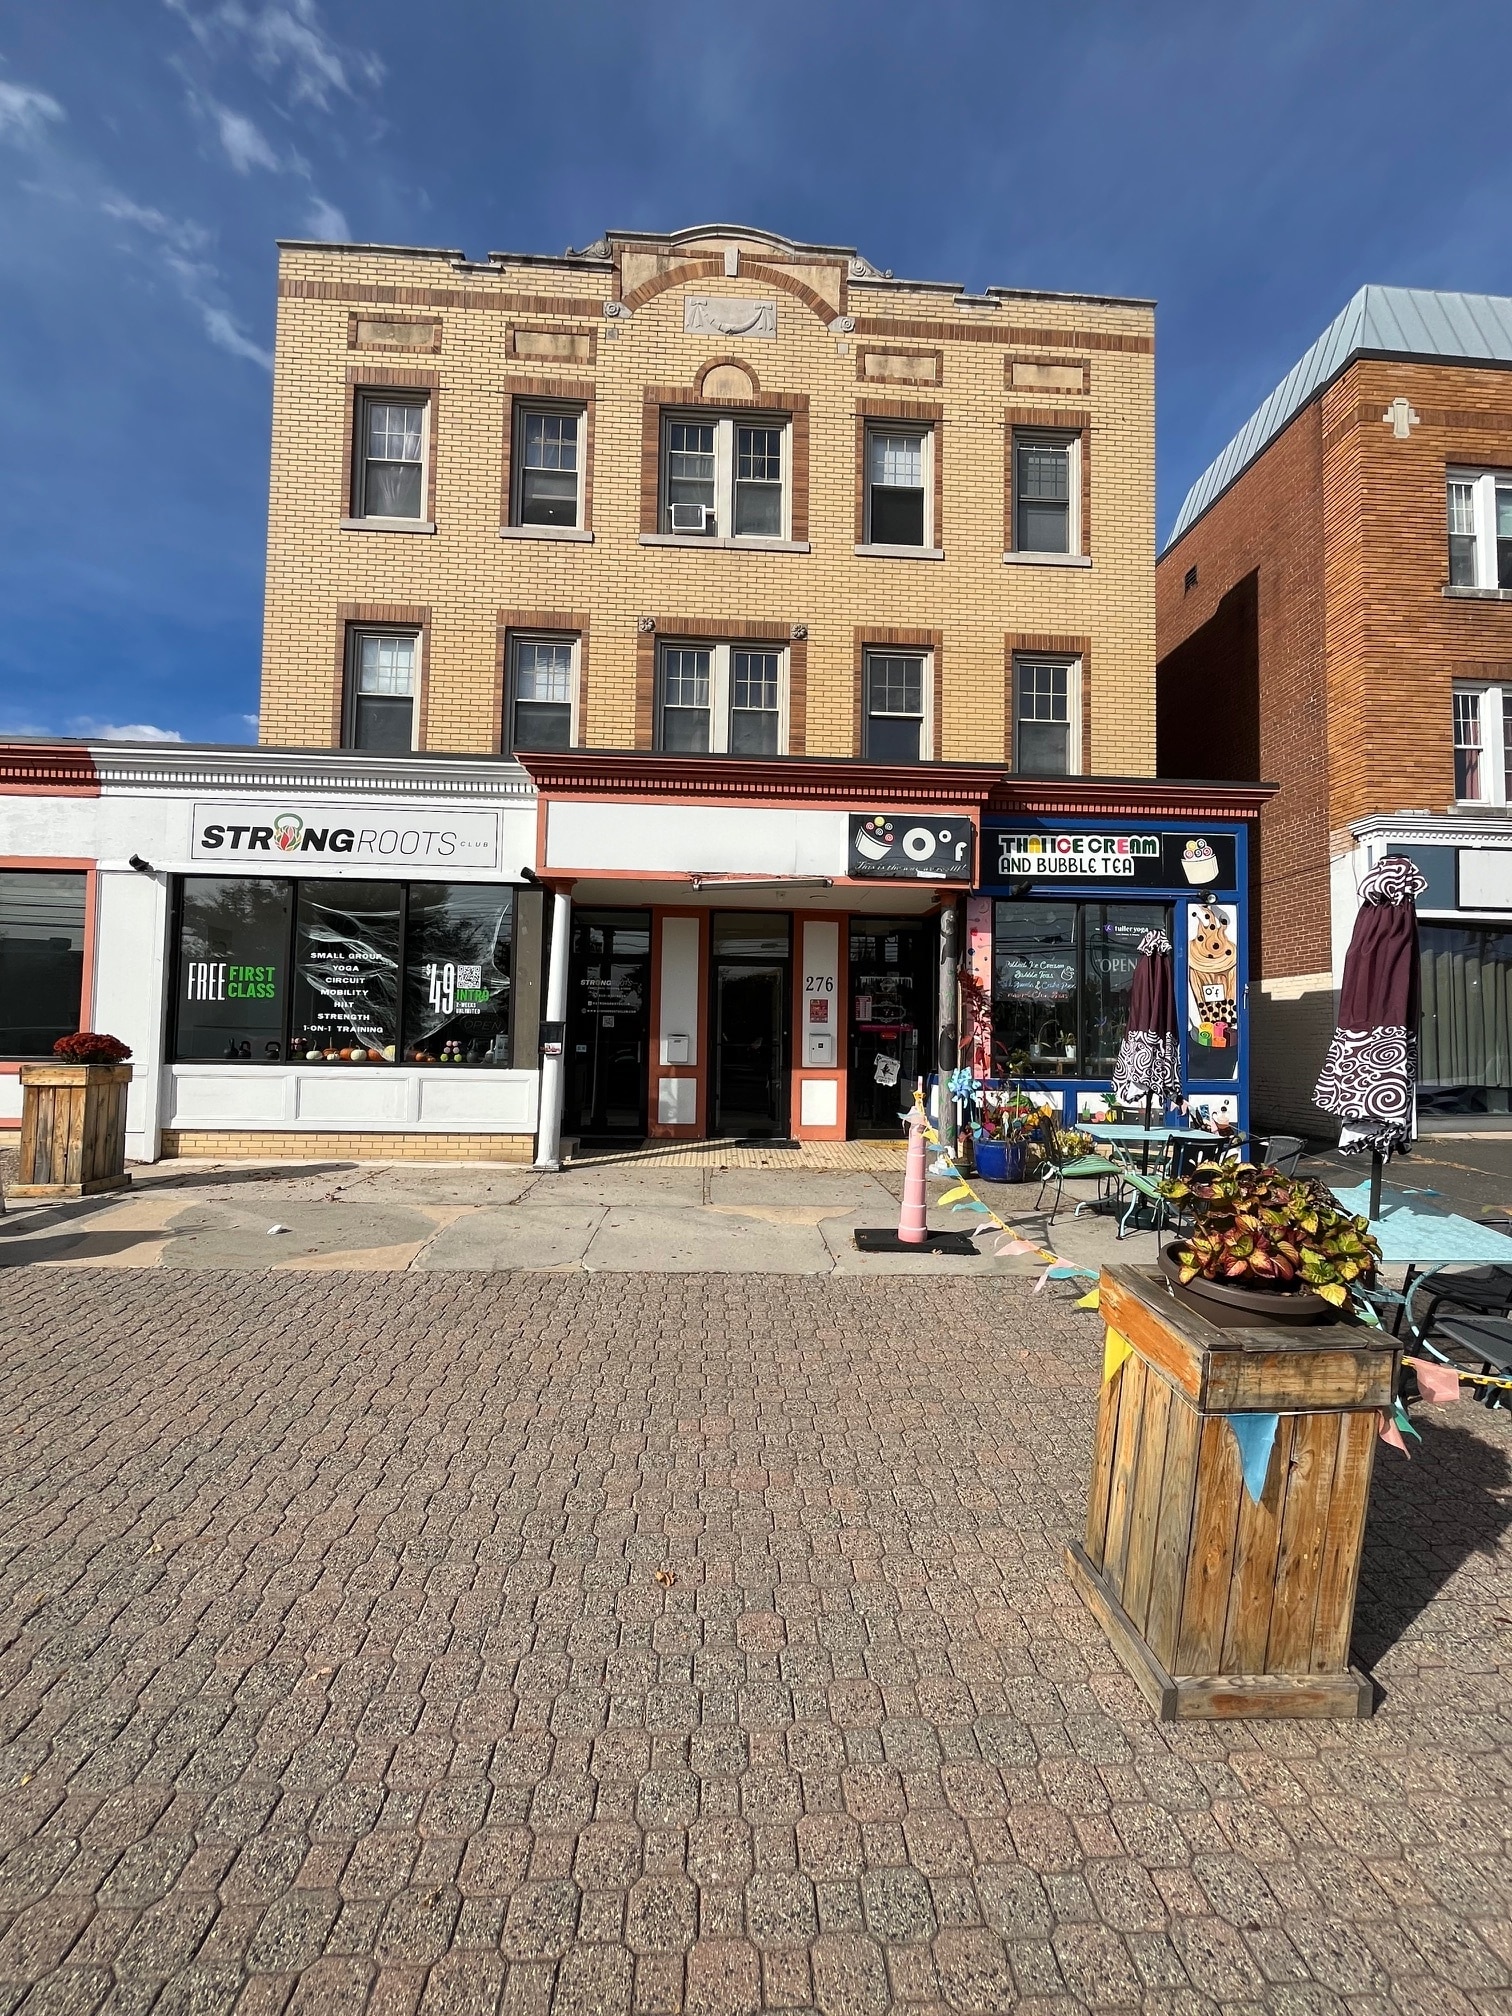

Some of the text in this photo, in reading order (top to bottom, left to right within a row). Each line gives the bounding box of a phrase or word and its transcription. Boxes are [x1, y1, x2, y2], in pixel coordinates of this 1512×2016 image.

[460, 840, 490, 848] CLUB
[1001, 836, 1157, 854] THAI ICE CREAM
[1001, 857, 1132, 874] AND BUBBLE TEA
[1099, 958, 1138, 973] OPEN
[187, 962, 276, 1001] FREE FIRST
[805, 976, 834, 992] 276
[227, 982, 276, 998] CLASS
[456, 988, 490, 1002] INTRO
[336, 1025, 384, 1033] TRAINING
